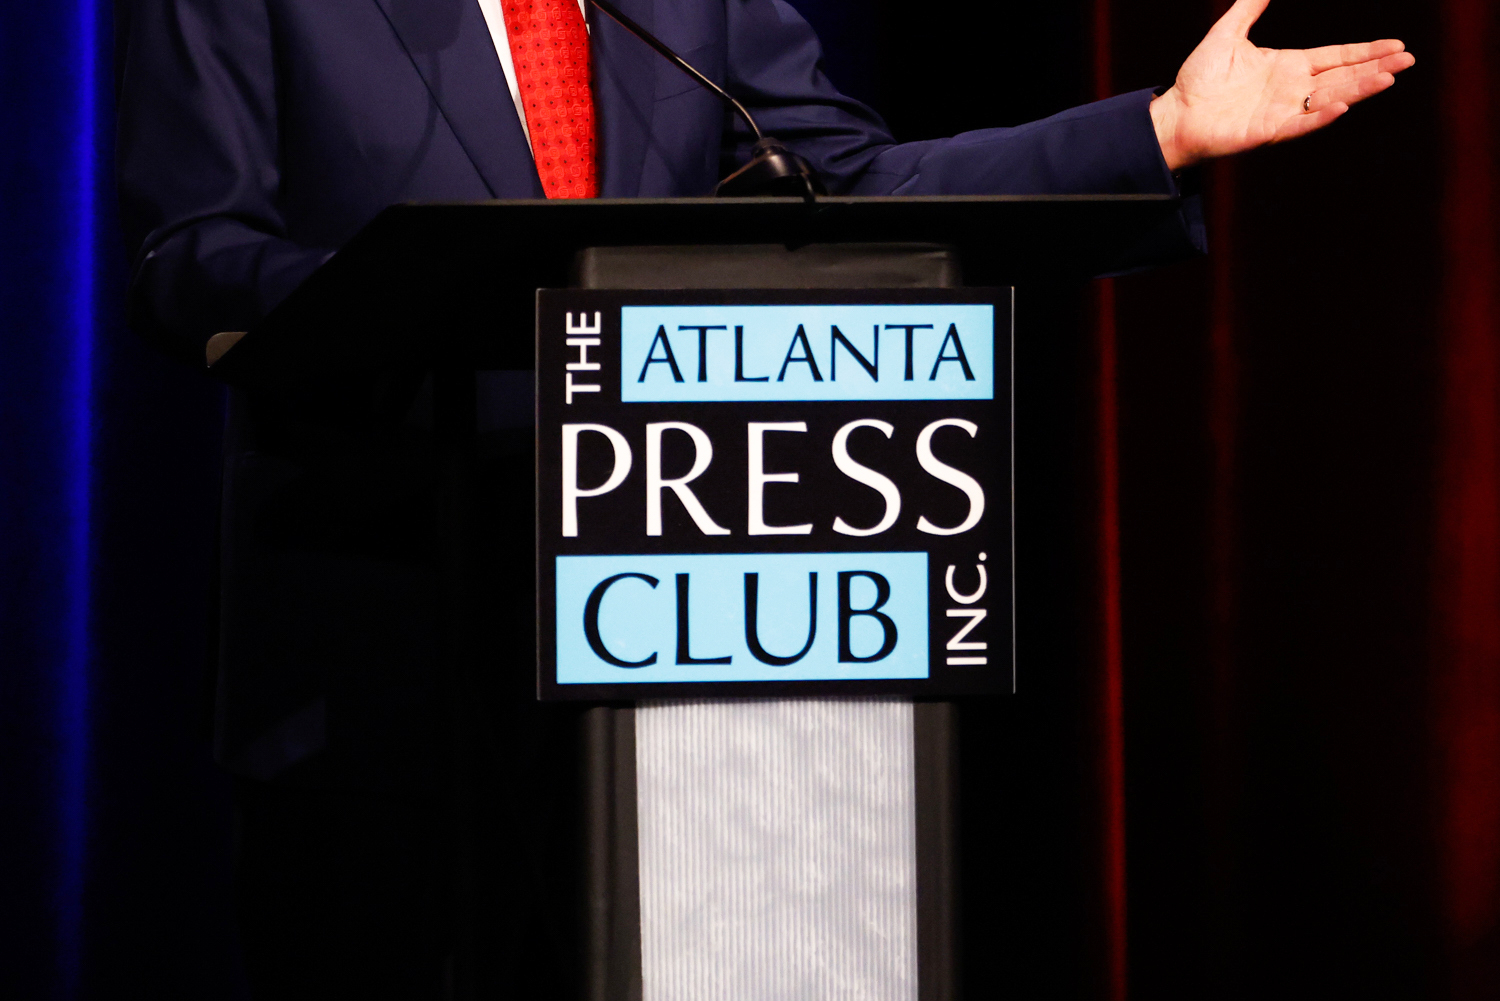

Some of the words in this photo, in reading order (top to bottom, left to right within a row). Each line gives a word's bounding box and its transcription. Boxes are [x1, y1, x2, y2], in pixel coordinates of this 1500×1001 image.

[565, 311, 601, 405] THE
[637, 323, 976, 383] ATLANTA
[562, 418, 985, 537] PRESS
[583, 570, 898, 669] CLUB
[945, 551, 987, 665] INC.
